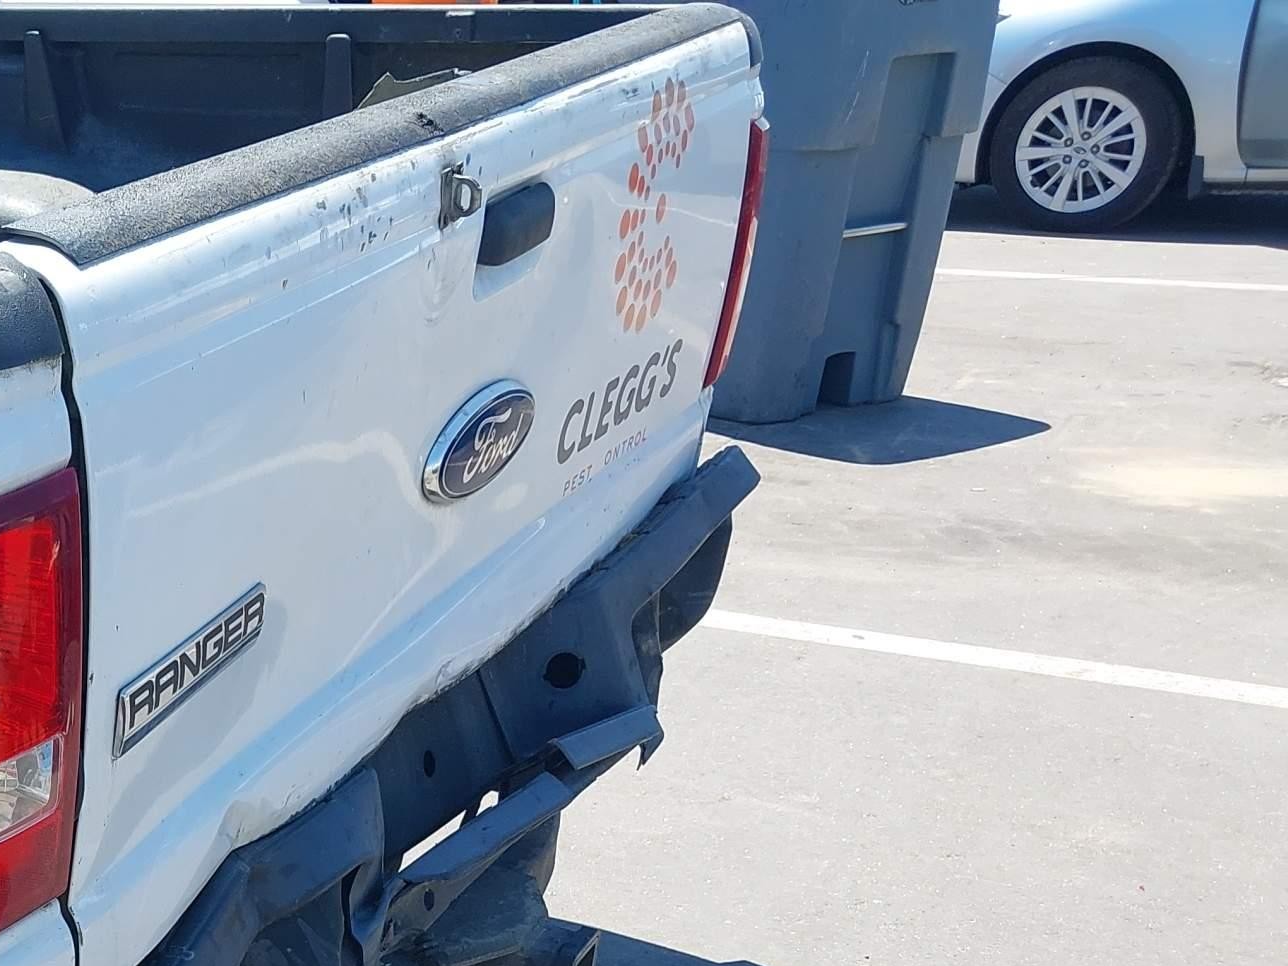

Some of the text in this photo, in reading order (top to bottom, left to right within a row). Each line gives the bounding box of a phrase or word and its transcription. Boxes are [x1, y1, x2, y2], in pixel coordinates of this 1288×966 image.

[462, 406, 524, 484] Ford
[557, 338, 683, 465] CLEGG'S
[562, 465, 593, 496] PEST
[128, 592, 265, 730] RANGER
